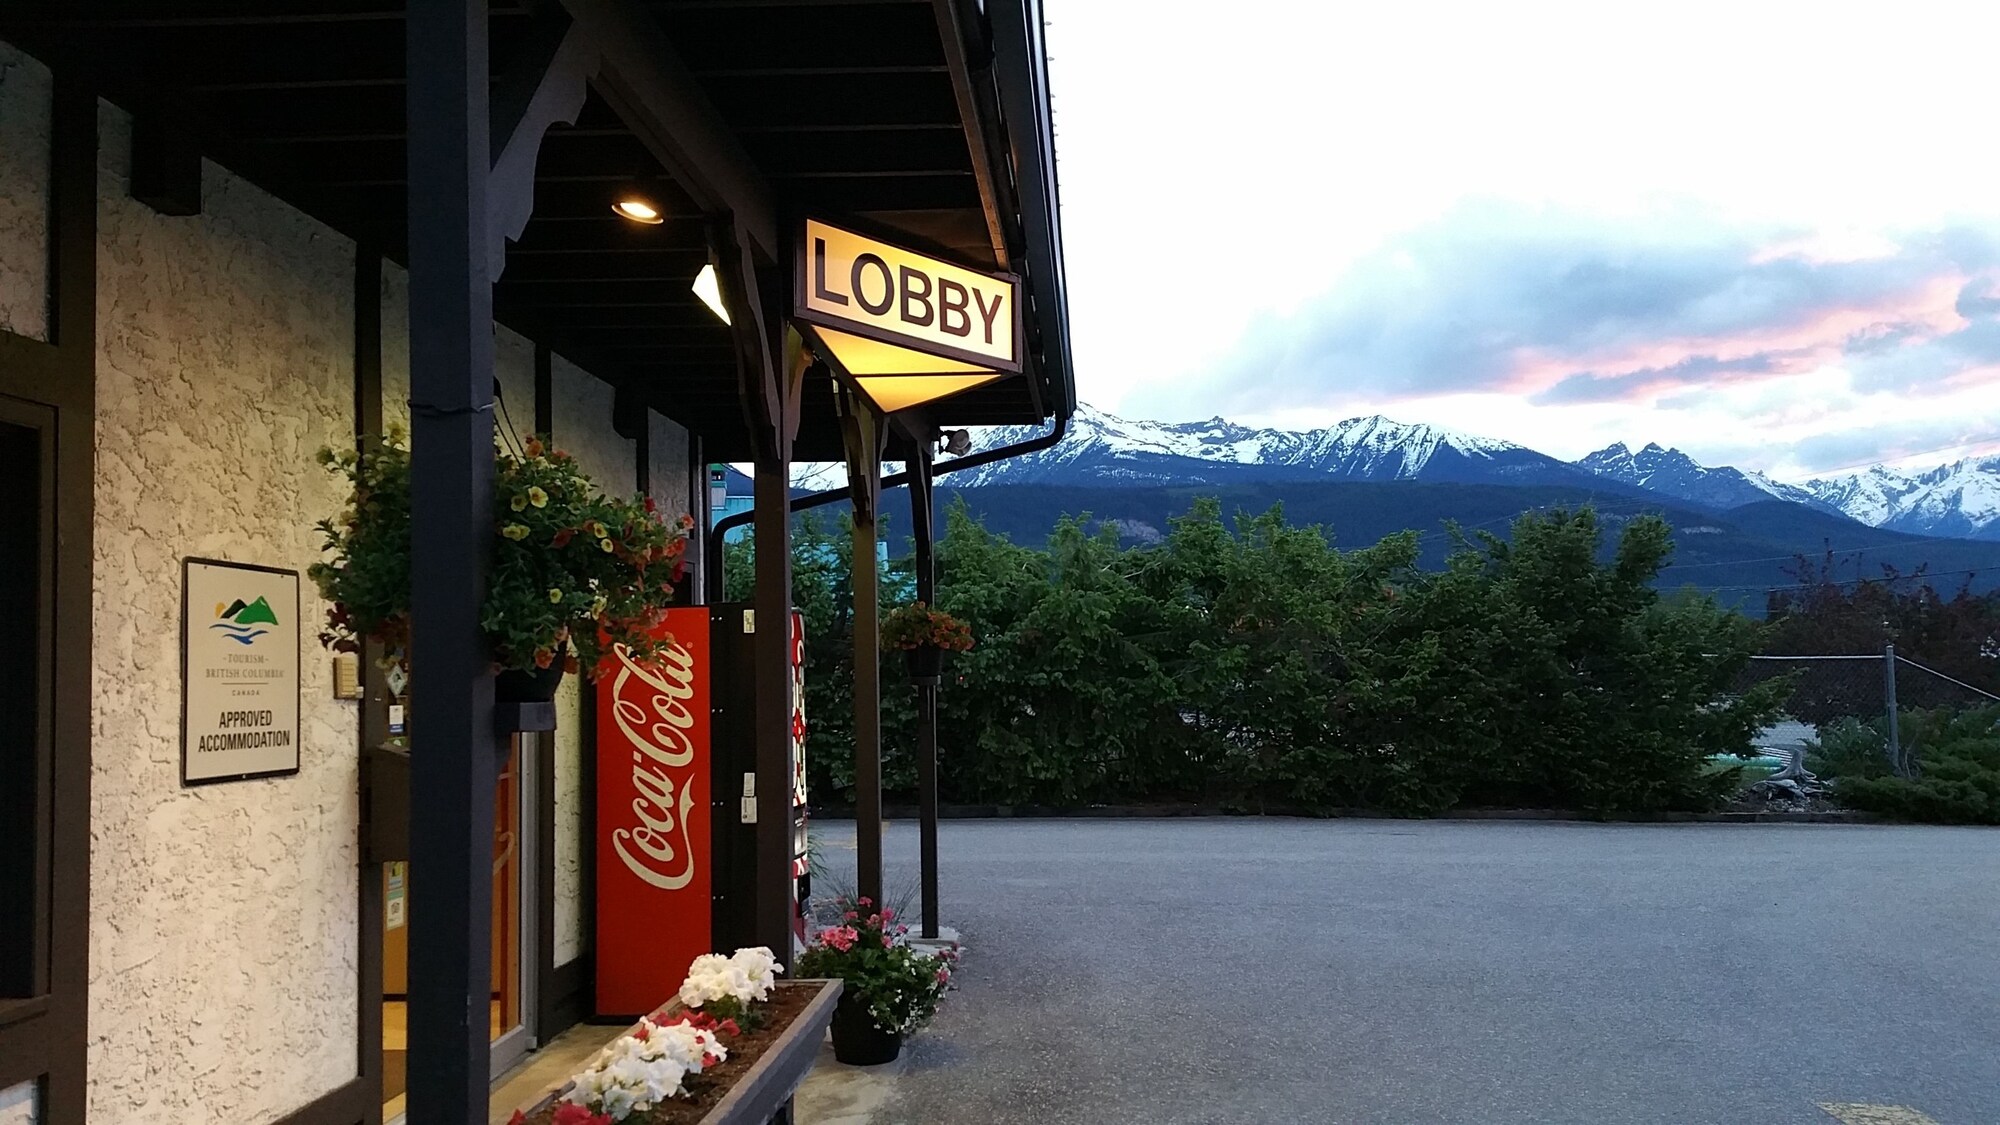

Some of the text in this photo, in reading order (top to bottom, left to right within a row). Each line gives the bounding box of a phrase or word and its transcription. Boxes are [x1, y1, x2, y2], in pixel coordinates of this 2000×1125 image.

[814, 236, 1004, 345] LOBBY
[205, 668, 284, 679] BRITISH COLUMBIA
[231, 689, 261, 697] CANADA
[218, 709, 273, 729] APPROVED
[198, 729, 291, 753] ACCOMMODATION
